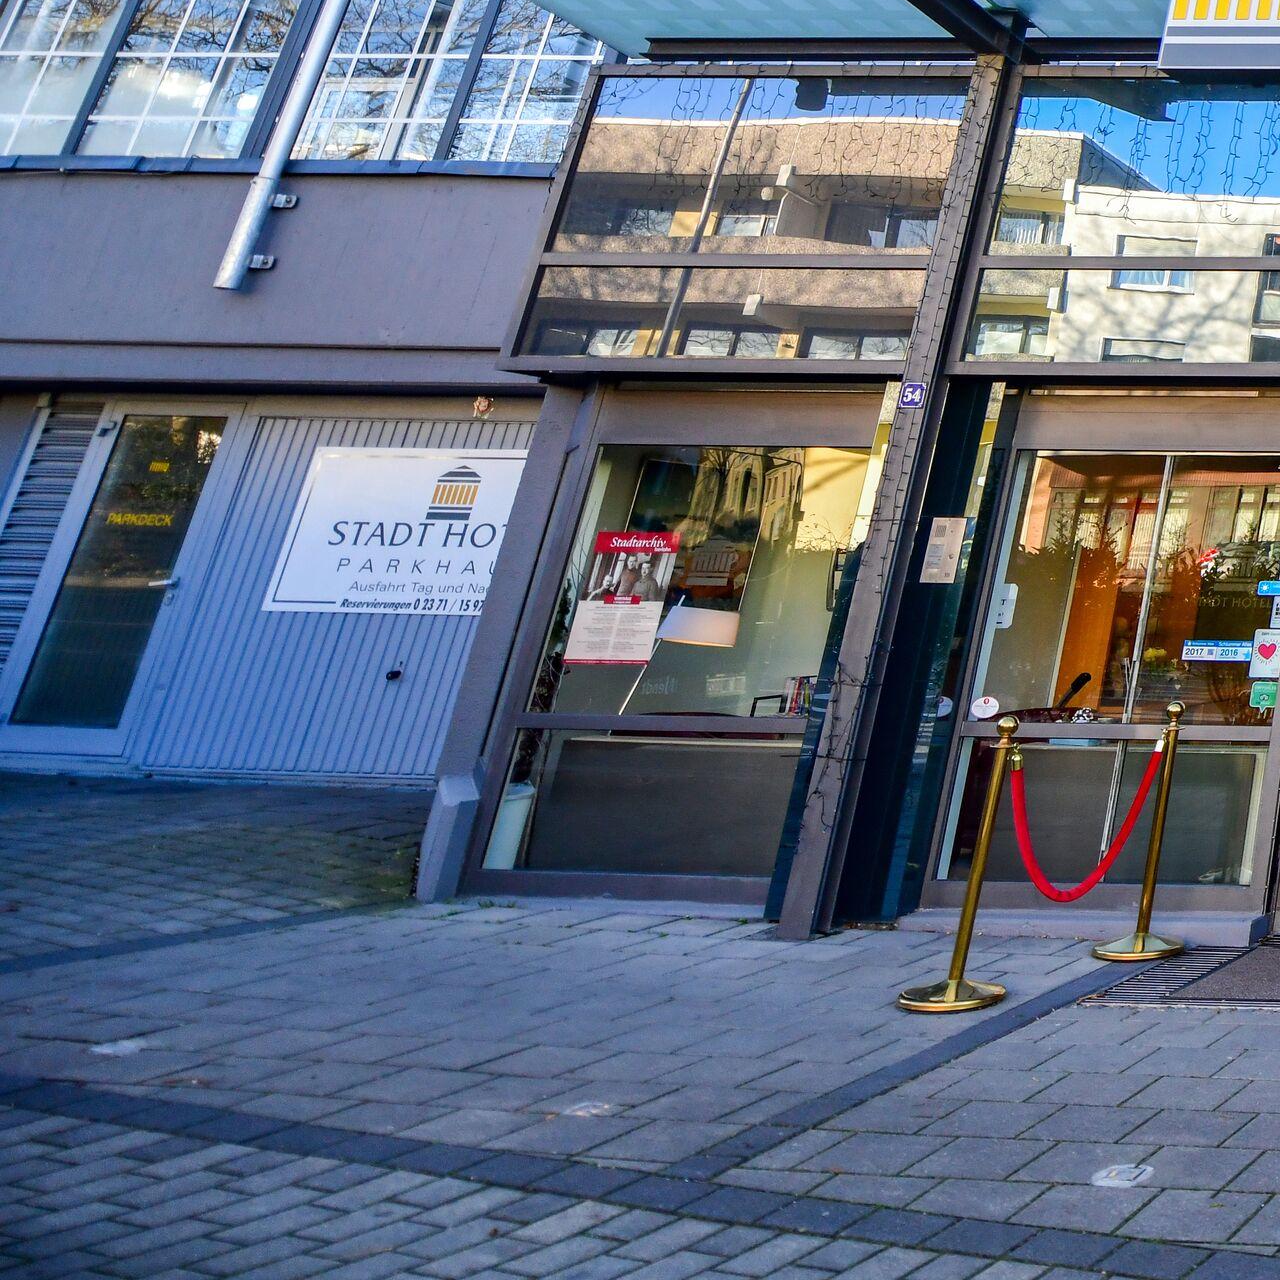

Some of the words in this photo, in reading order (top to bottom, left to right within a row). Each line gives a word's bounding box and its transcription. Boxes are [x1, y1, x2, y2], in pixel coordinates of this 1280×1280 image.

[905, 387, 922, 403] 54
[105, 512, 174, 527] PARKDECK
[328, 521, 437, 548] STADT
[442, 522, 507, 548] HO
[610, 535, 667, 548] Stadtarchiv
[349, 580, 406, 593] Ausfahrt
[411, 582, 434, 595] Tag
[438, 583, 462, 594] und
[340, 598, 413, 611] Reservierungen
[413, 599, 421, 610] 0
[422, 599, 434, 611] 23
[436, 599, 448, 611] 71
[459, 600, 470, 612] 15
[1184, 648, 1204, 656] 2017
[1220, 648, 1239, 657] 2016
